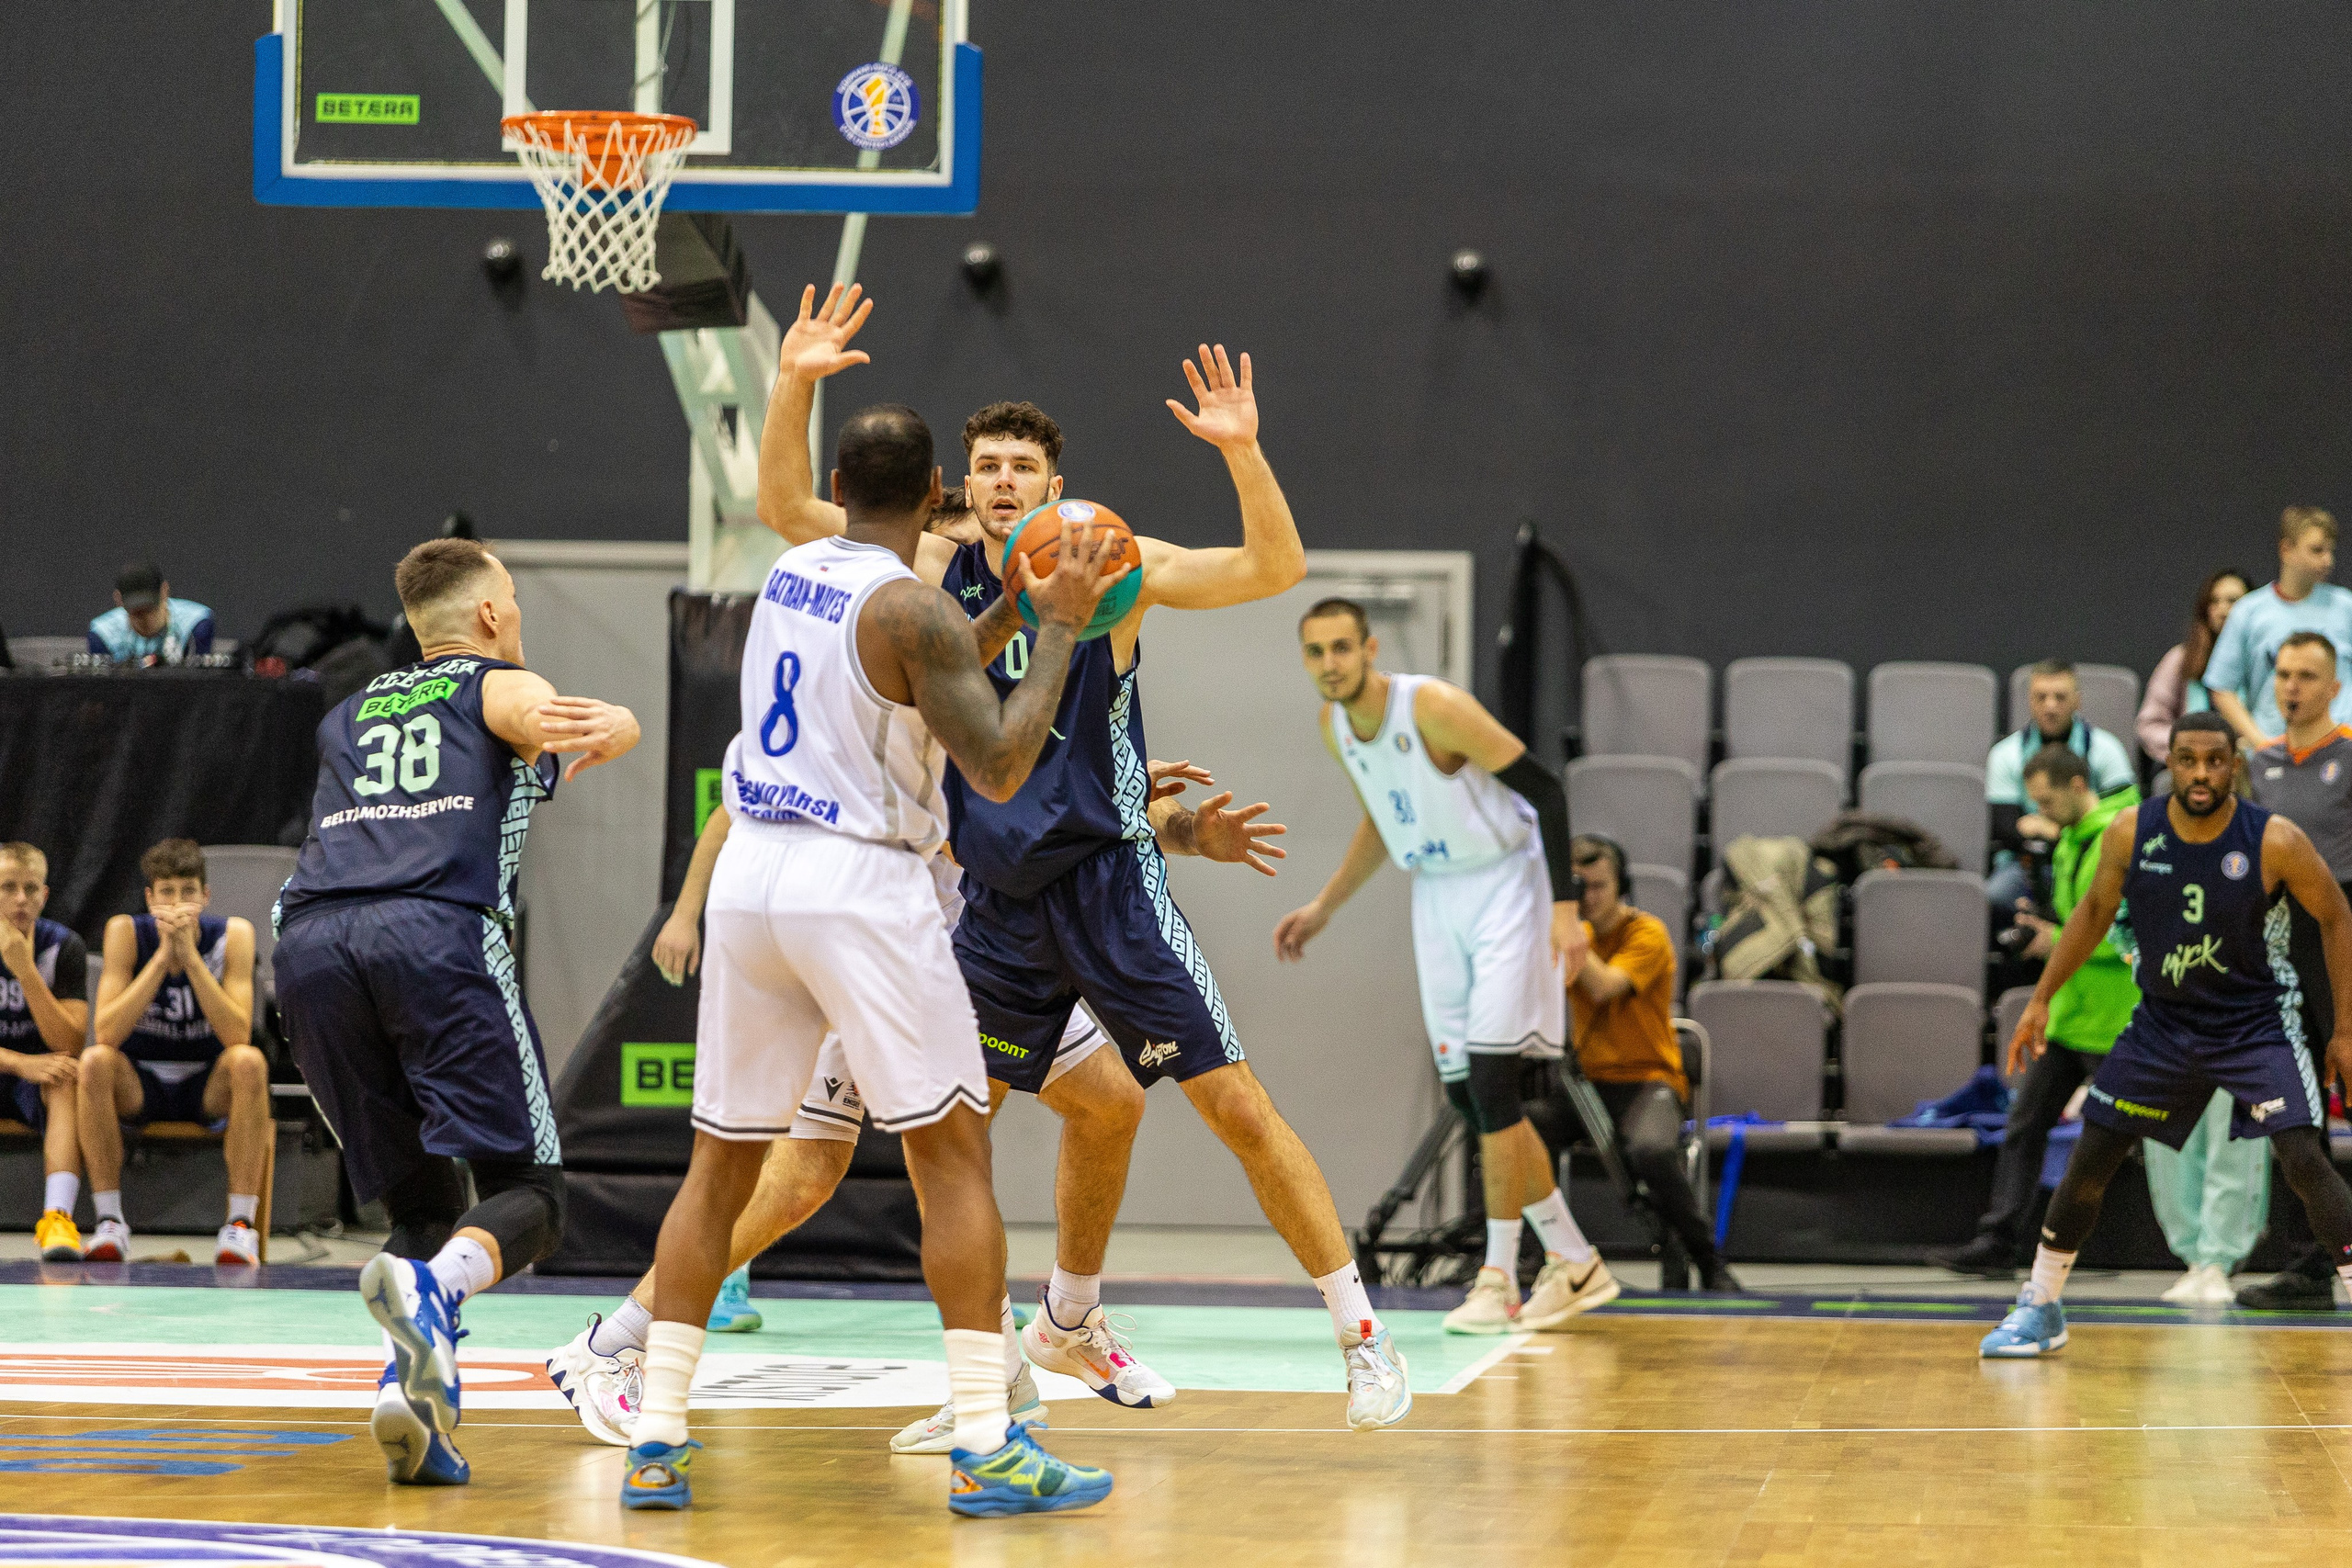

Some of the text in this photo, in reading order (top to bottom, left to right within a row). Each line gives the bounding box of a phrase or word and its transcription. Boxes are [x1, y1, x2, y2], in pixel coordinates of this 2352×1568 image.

[322, 99, 413, 117] BETERA
[365, 681, 448, 715] BETERA
[760, 650, 800, 757] 8
[353, 713, 441, 796] 38
[2182, 883, 2205, 924] 3
